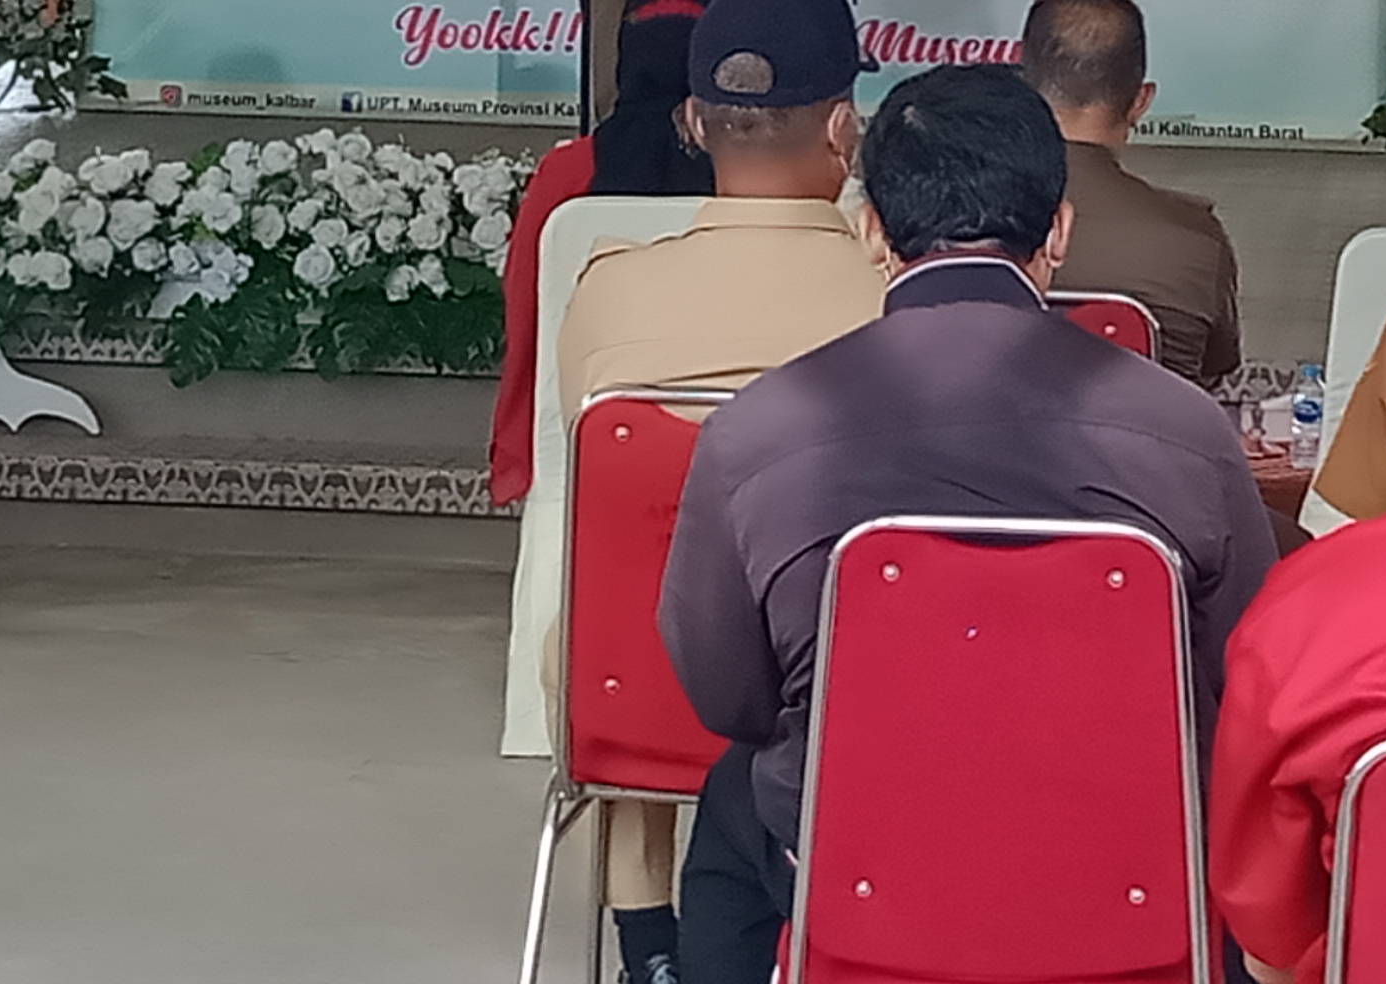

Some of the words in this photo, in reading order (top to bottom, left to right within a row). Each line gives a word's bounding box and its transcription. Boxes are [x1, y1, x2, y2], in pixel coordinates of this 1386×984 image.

[188, 93, 315, 110] museum_kalbar
[367, 96, 403, 112] UPT.
[409, 98, 477, 114] Museum
[482, 100, 549, 116] Provinsi
[1160, 121, 1253, 139] Kalimantan
[1260, 125, 1303, 140] Barat
